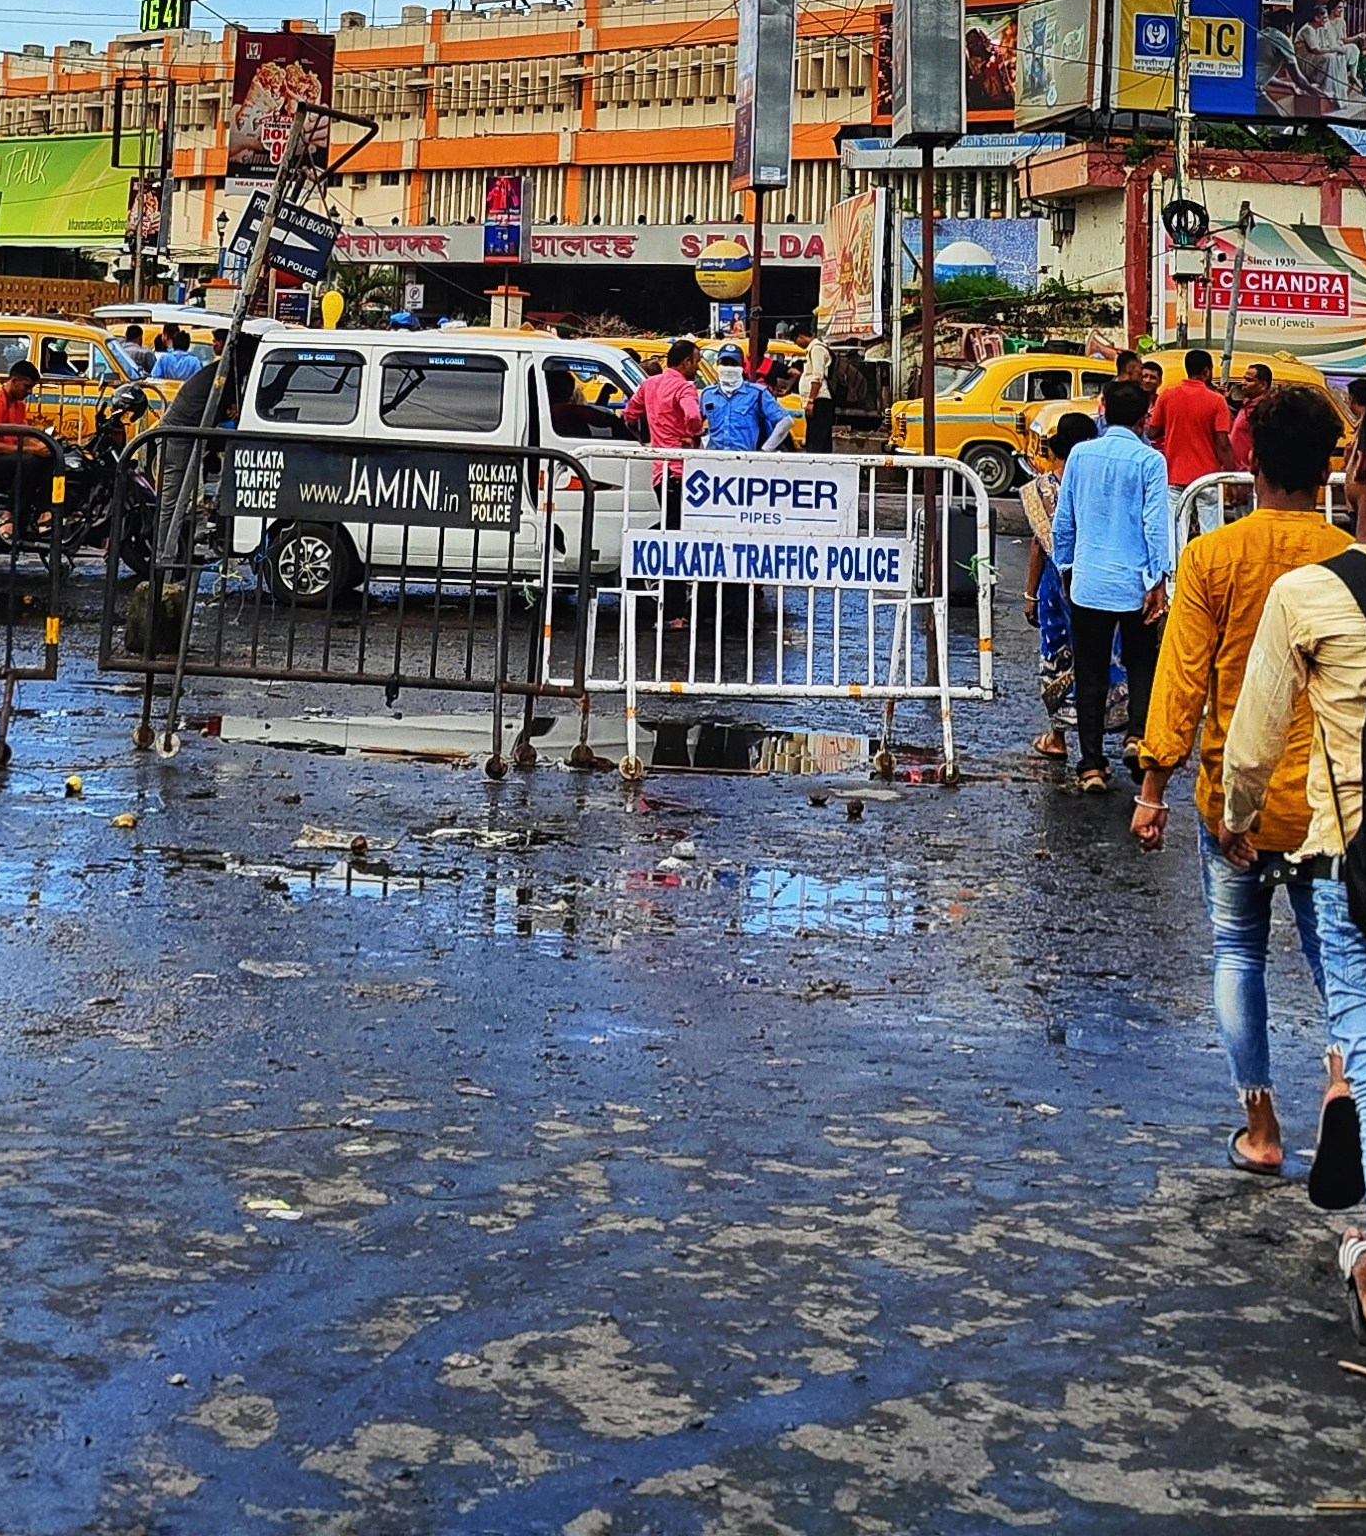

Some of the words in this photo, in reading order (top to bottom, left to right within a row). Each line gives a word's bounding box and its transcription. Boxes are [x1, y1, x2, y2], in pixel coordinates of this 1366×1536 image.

[263, 129, 289, 141] ROL
[983, 135, 1020, 147] Station
[5, 145, 53, 187] TALK
[307, 218, 335, 240] BOOTH
[531, 234, 637, 259] यालदह
[286, 259, 319, 280] POLICE
[1246, 256, 1273, 267] Since
[1275, 257, 1297, 267] 1939
[1245, 272, 1345, 294] CHANDRA
[1238, 315, 1267, 327] jewel
[1269, 316, 1281, 327] of
[1282, 318, 1315, 329] jewels
[233, 449, 285, 470] KOLKATA
[234, 469, 282, 490] TRAFFIC
[468, 463, 518, 484] KOLKATA
[299, 457, 459, 513] www.JAMINI.in
[469, 483, 515, 504] TRAFFIC
[685, 468, 839, 510] SKIPPER
[235, 490, 277, 509] POLICE
[470, 503, 512, 524] POLICE
[739, 511, 782, 526] PIPES
[631, 539, 728, 579] KOLKATA
[732, 542, 819, 582] TRAFFIC
[826, 546, 900, 584] POLICE
